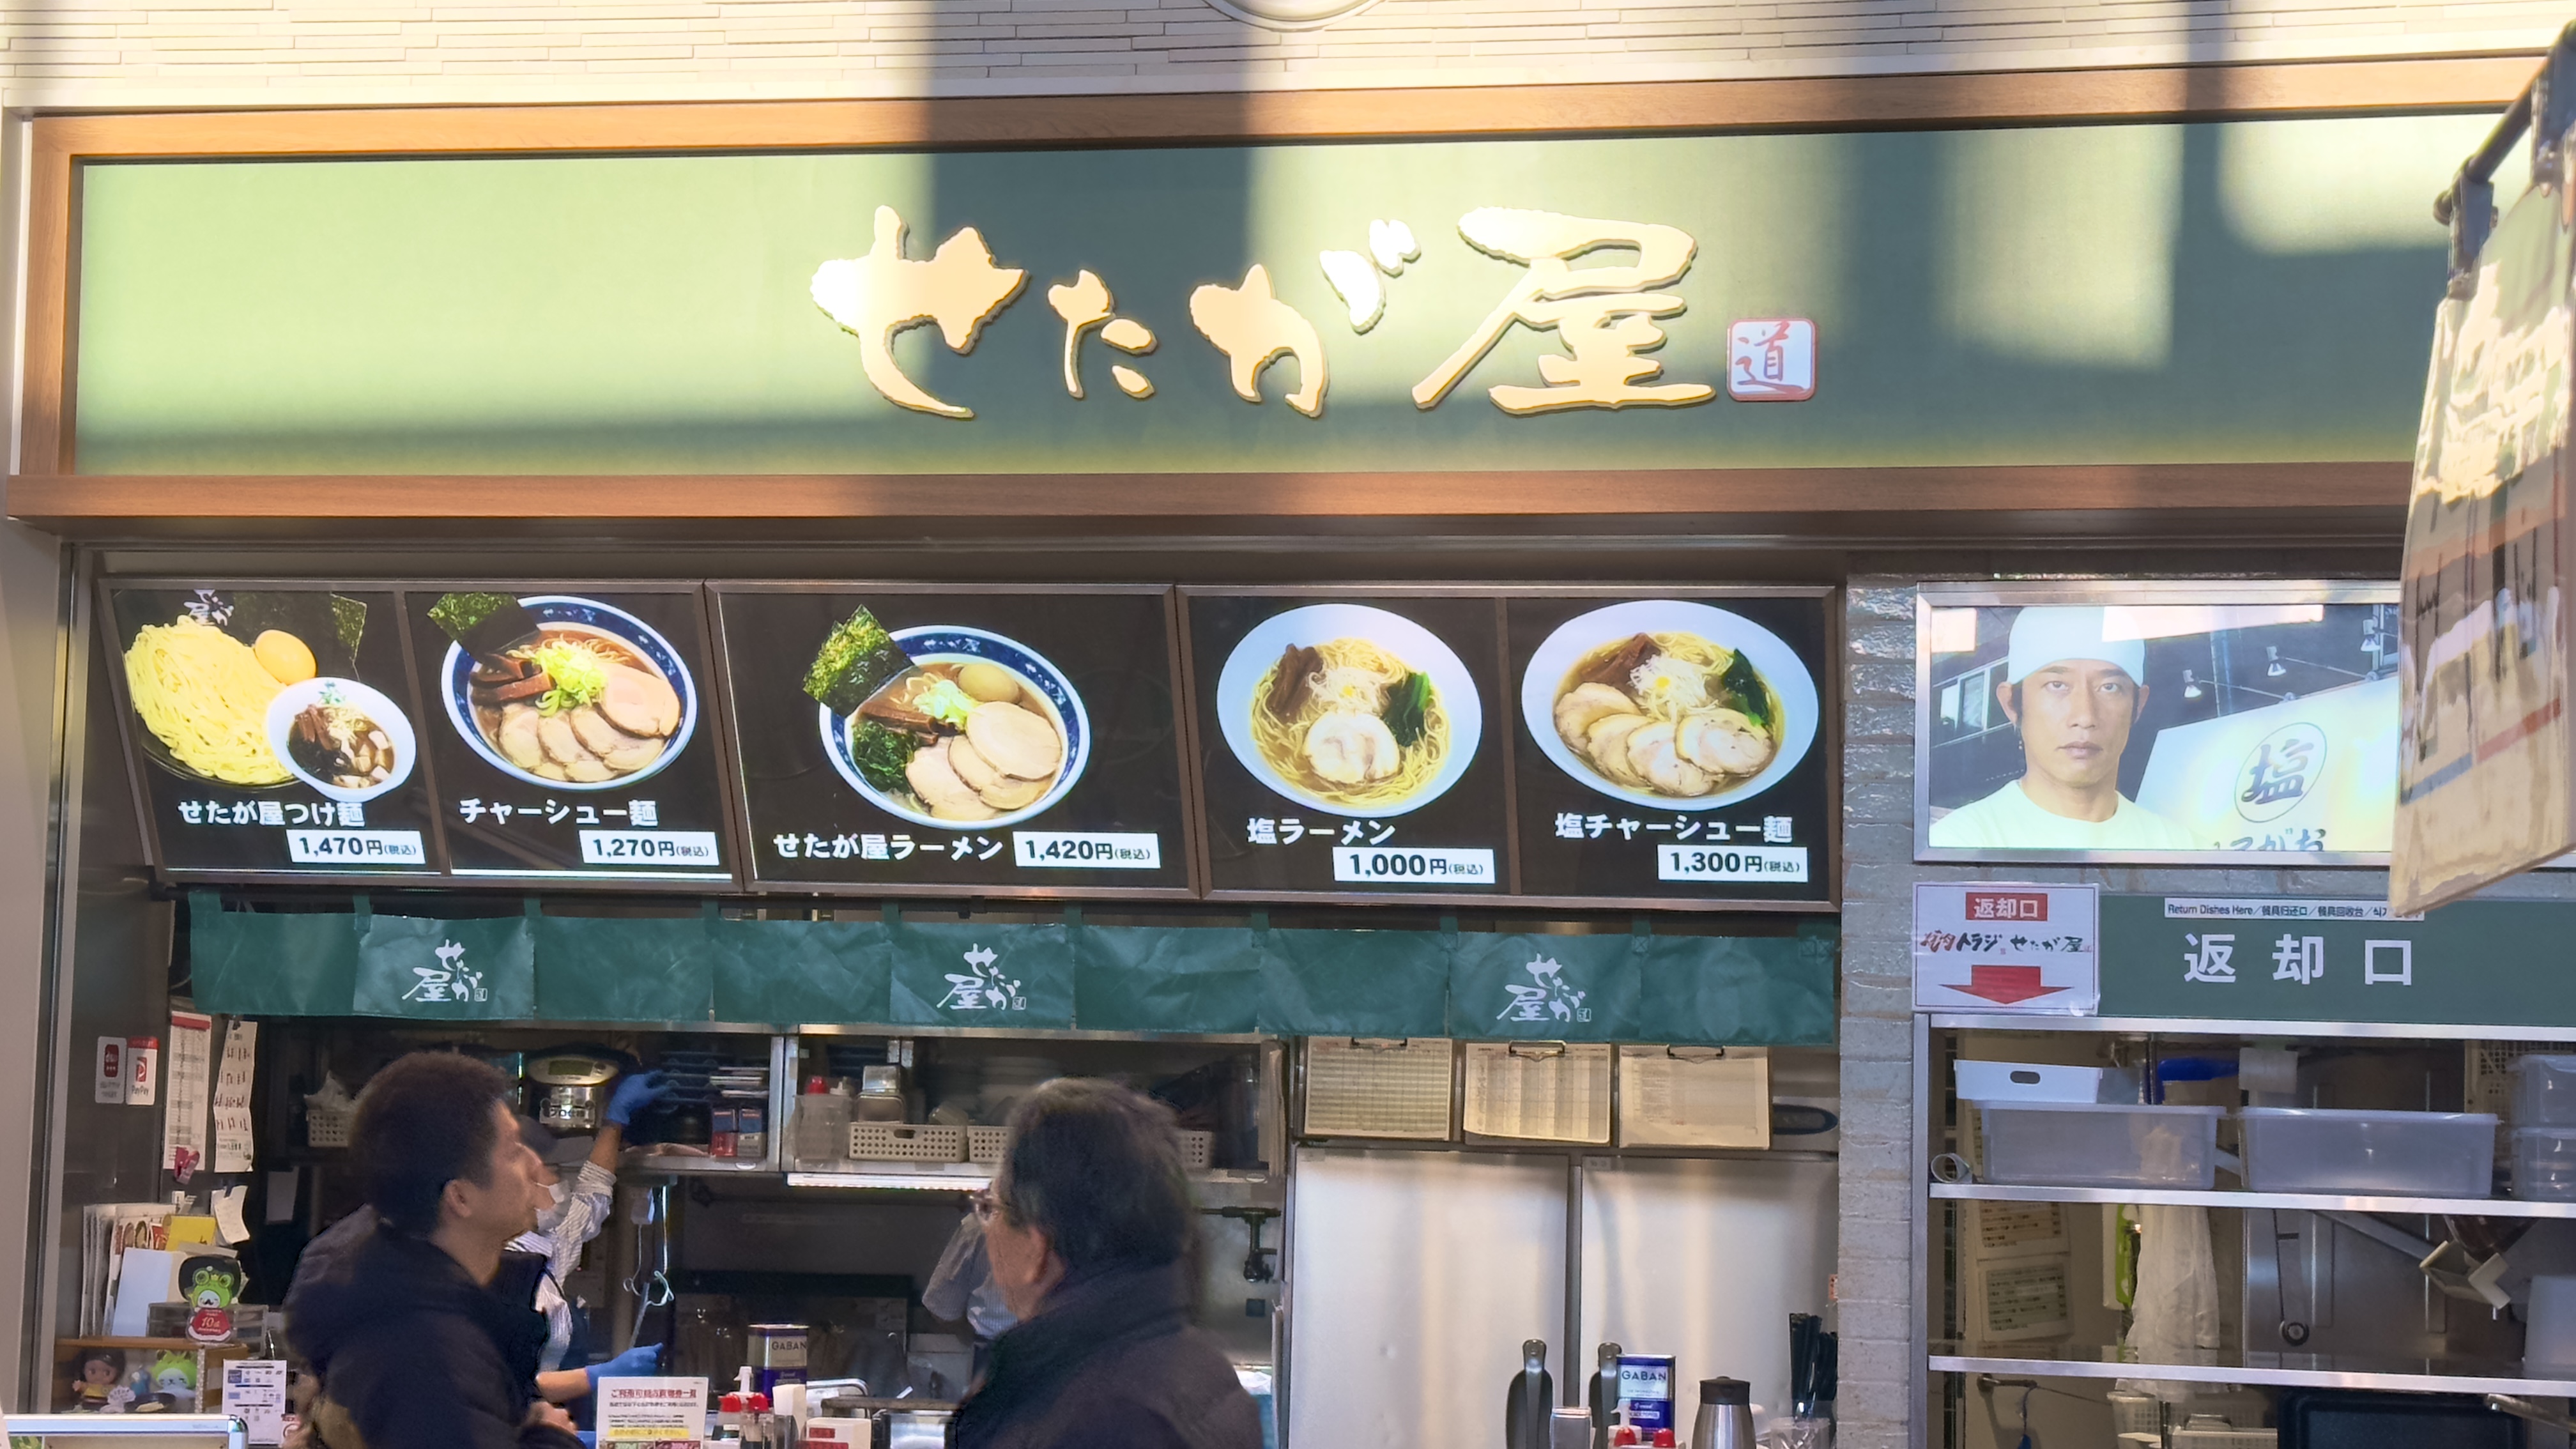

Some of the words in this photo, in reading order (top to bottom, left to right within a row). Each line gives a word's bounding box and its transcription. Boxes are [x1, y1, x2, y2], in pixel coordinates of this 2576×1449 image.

[810, 204, 1716, 419] せたが屋
[1734, 319, 1805, 395] 道
[2241, 739, 2314, 805] 塩
[178, 799, 365, 827] せたが屋つけ麺
[459, 798, 659, 827] チャーシュー麺
[1247, 817, 1396, 845] 塩ラーメン
[1555, 813, 1793, 843] 塩チャーシュー麺
[773, 832, 1003, 861] せたが屋ラーメン
[1974, 897, 2038, 919] 返却口
[2168, 903, 2198, 914] Return
[2200, 904, 2230, 915] Dishes
[2010, 934, 2083, 953] せたが屋
[2184, 933, 2412, 986] 返却口
[771, 1341, 807, 1350] GABAN
[1621, 1370, 1666, 1381] GABAN
